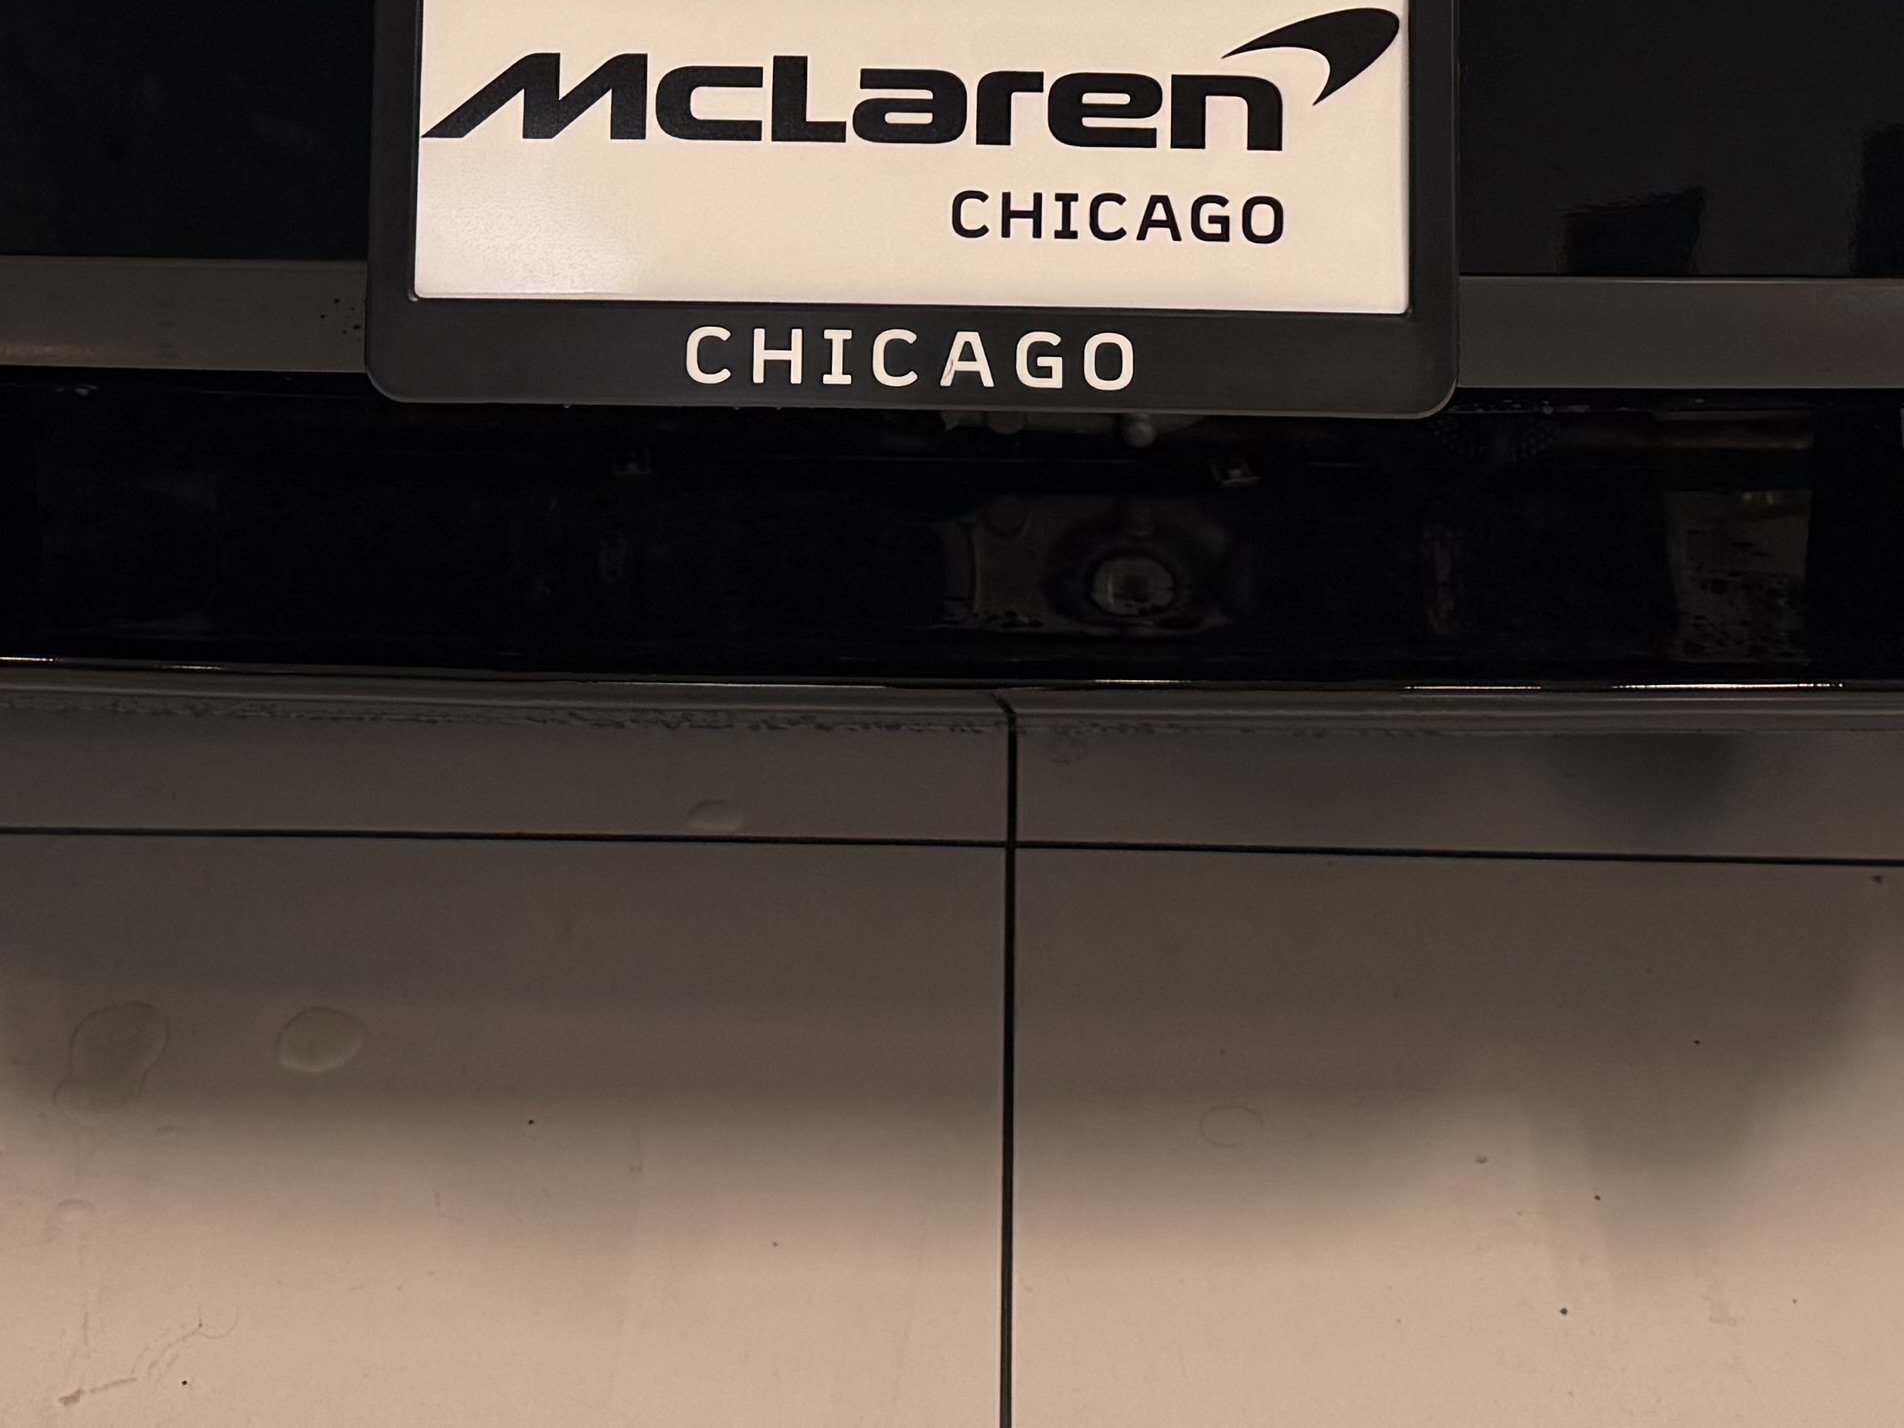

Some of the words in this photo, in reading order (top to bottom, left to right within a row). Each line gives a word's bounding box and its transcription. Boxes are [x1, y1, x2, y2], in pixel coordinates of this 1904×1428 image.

[420, 51, 1285, 152] McLaren
[949, 189, 1286, 245] CHICAGO
[683, 325, 1137, 392] CHICAGO
